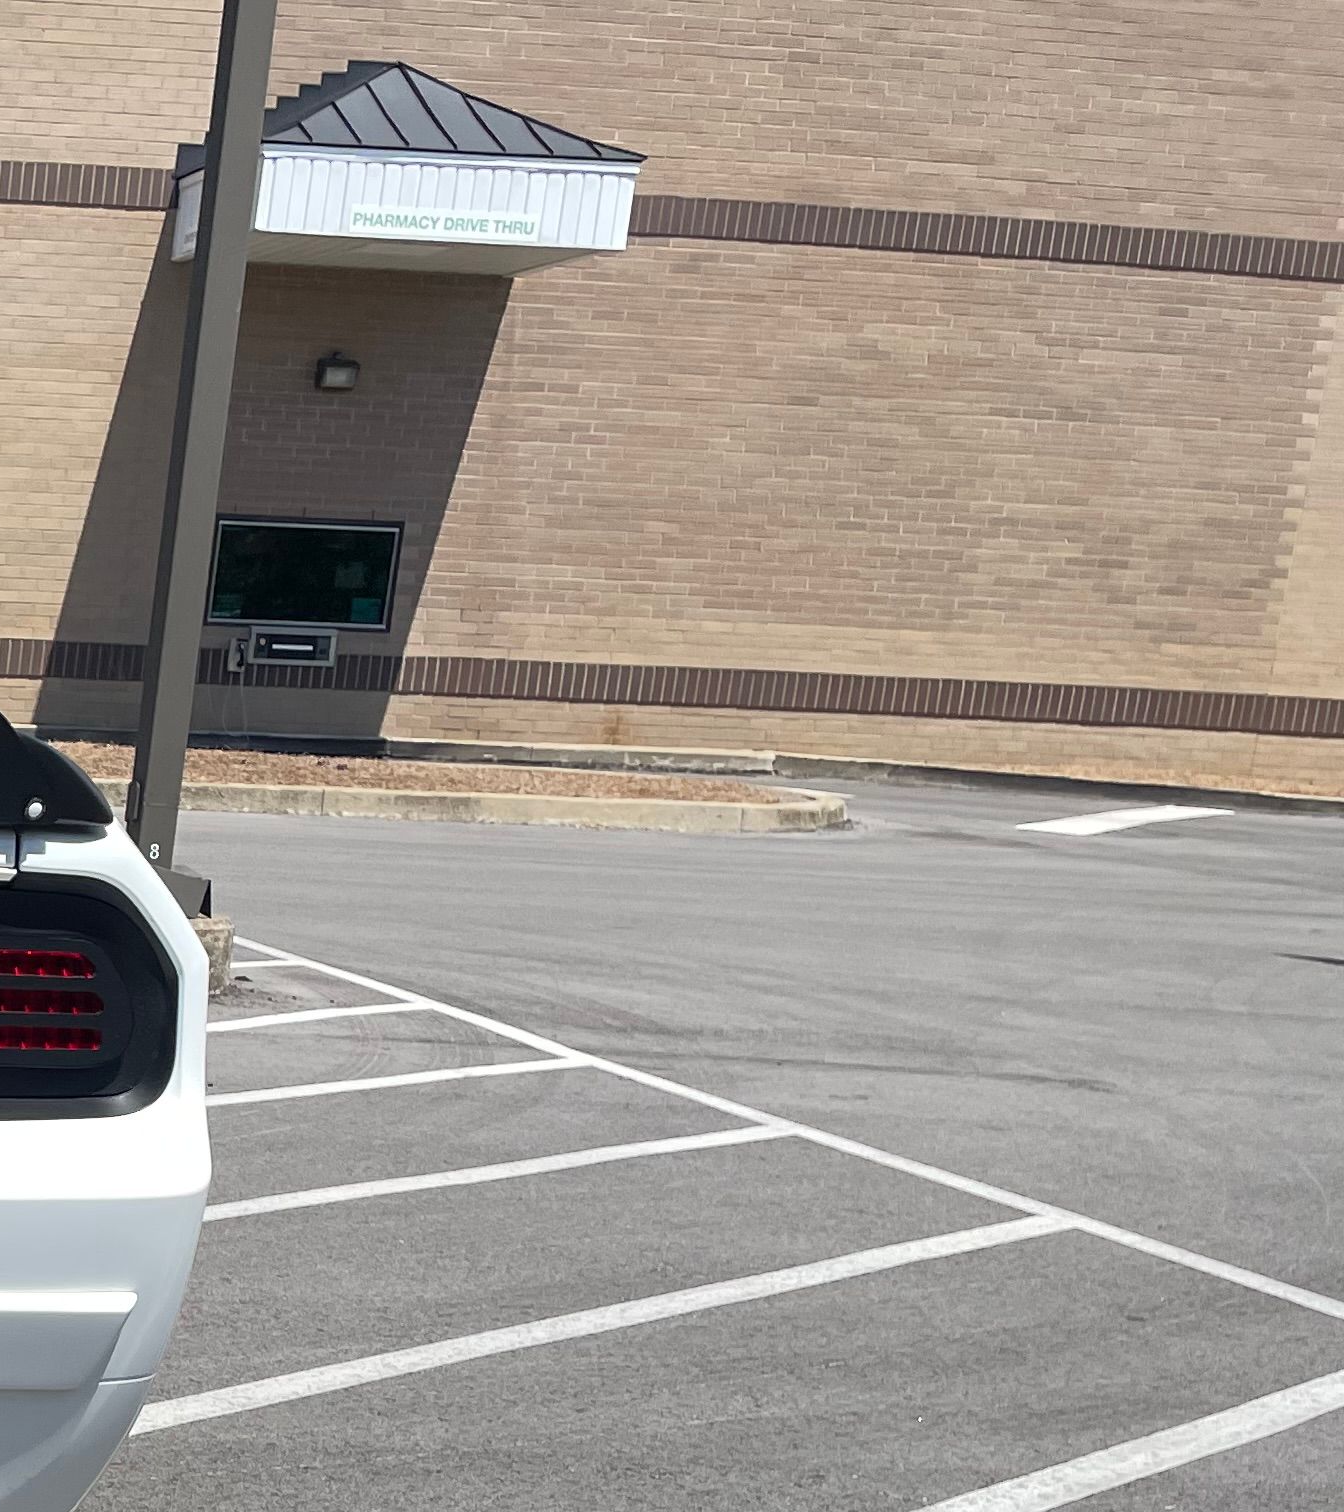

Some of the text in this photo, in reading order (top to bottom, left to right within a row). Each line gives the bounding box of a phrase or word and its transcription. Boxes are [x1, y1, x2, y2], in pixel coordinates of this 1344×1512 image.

[352, 212, 535, 235] PHARMACY DRIVE THRU
[149, 843, 160, 859] 8
